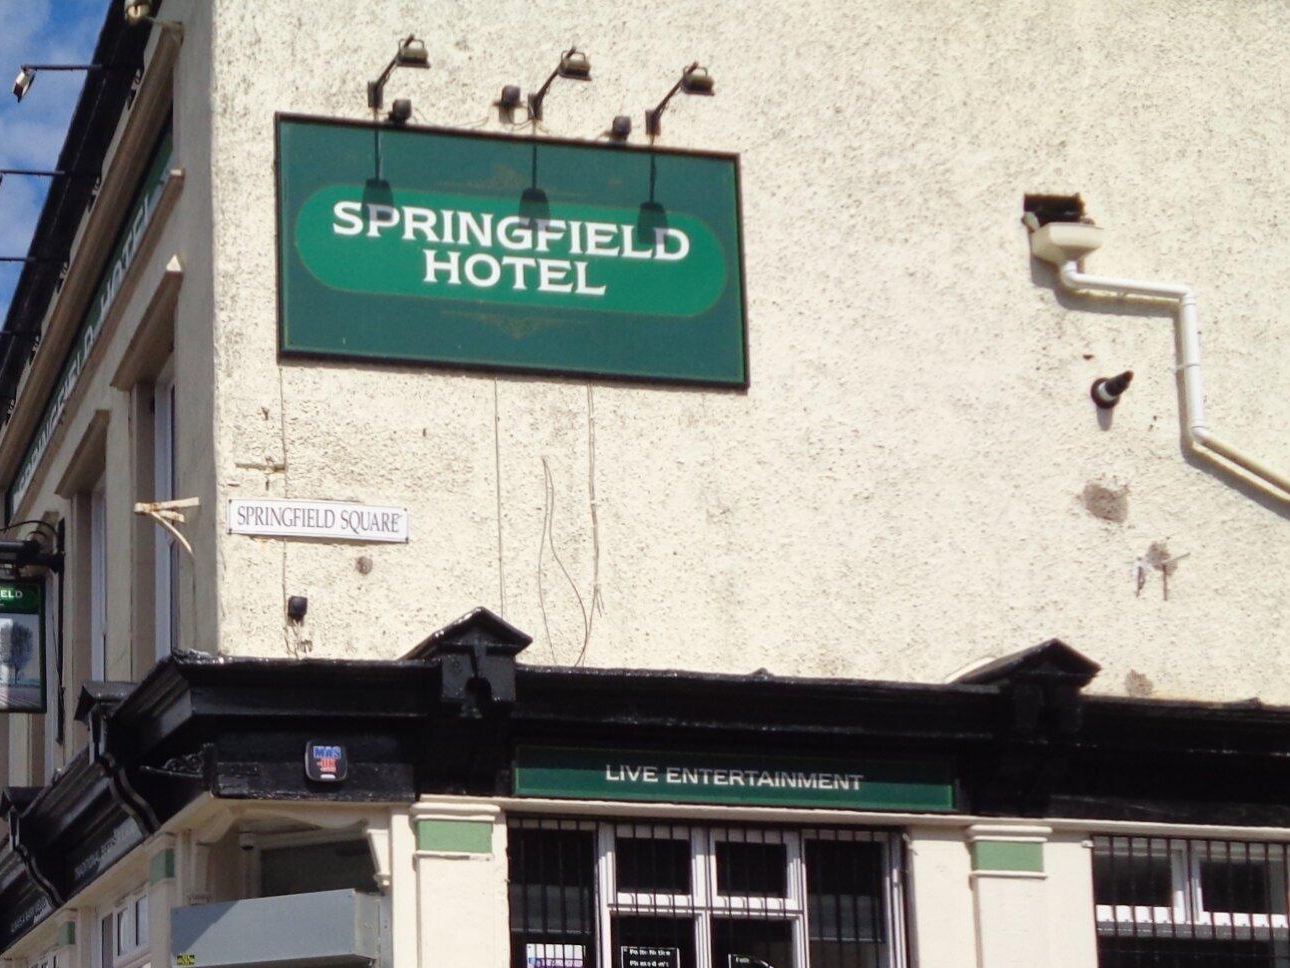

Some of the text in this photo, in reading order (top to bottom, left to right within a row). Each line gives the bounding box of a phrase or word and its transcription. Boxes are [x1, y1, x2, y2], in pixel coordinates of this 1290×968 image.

[332, 200, 690, 262] SPRINGFIELD
[422, 248, 607, 295] HOTEL
[236, 505, 401, 534] SPRINGFIELD SQUARE
[606, 764, 864, 791] LIVE ENTERTAINMENT
